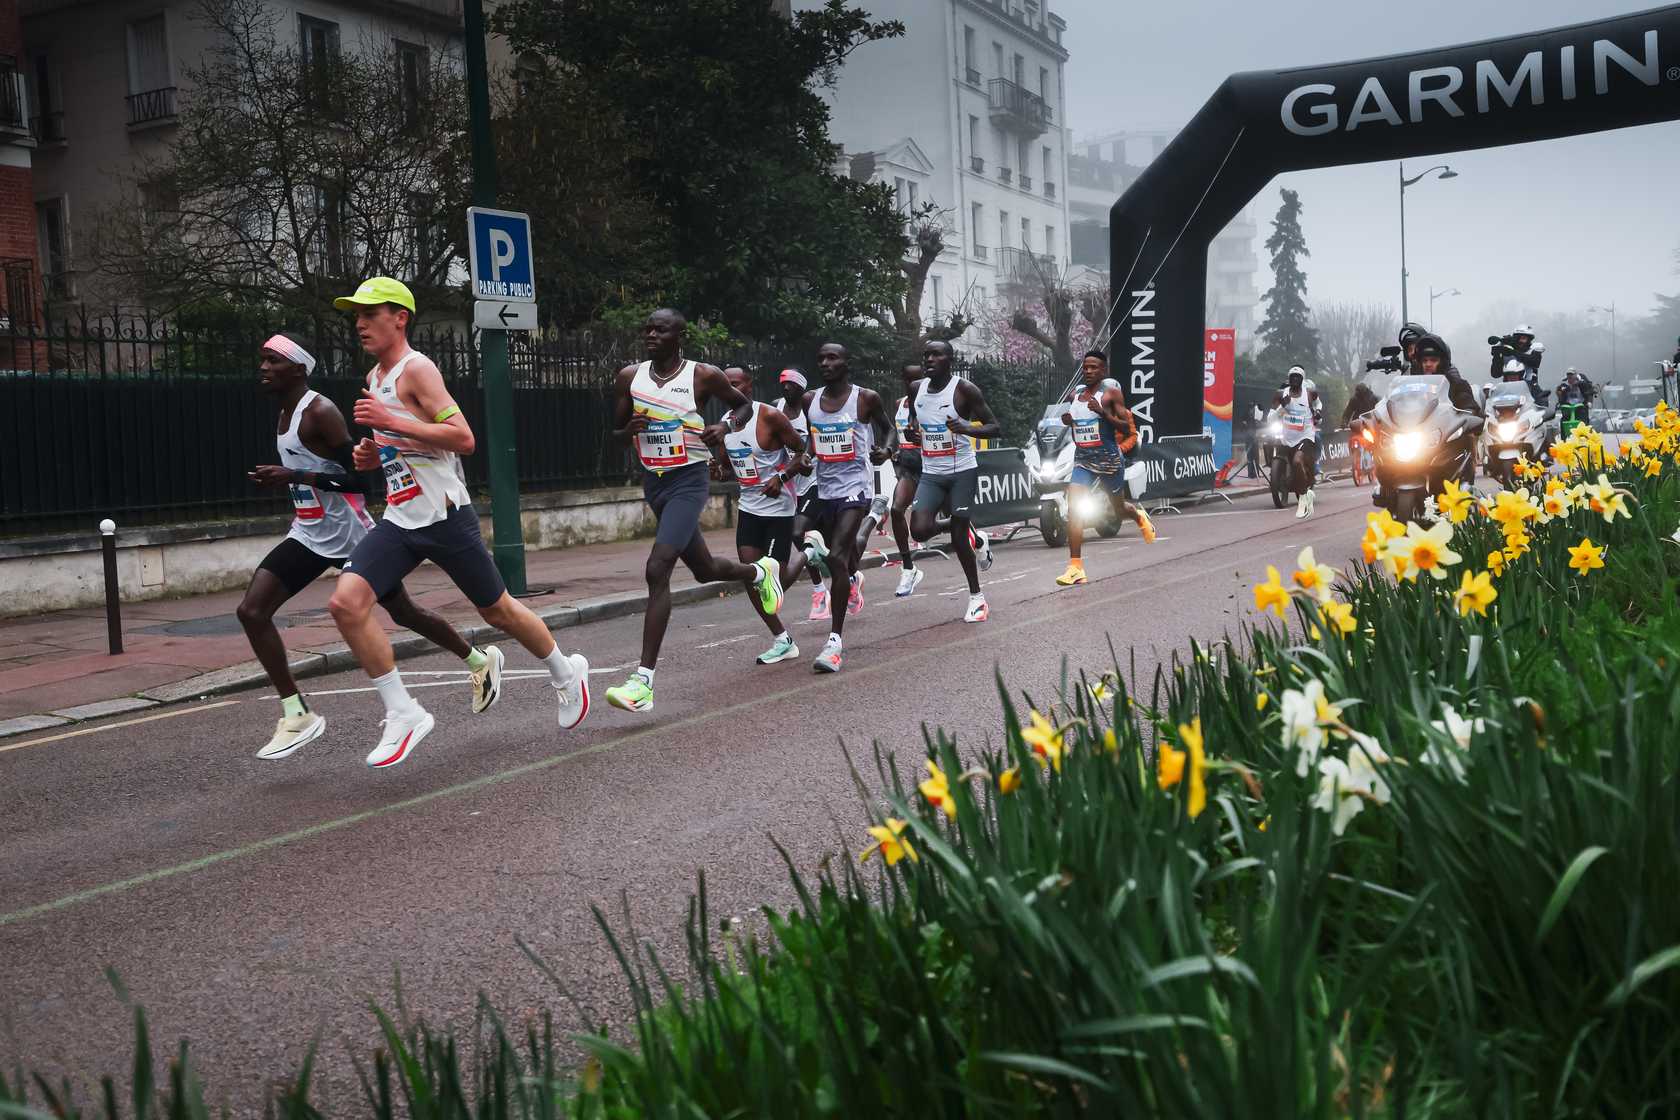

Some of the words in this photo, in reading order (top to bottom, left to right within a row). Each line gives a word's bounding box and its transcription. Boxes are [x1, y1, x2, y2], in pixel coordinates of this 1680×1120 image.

[1280, 29, 1660, 136] GARMIN
[488, 228, 515, 281] P
[479, 280, 508, 296] PARKING
[509, 282, 532, 297] PUBLIC
[646, 433, 672, 445] KIMELI
[818, 433, 846, 444] KIMUTAI
[657, 446, 663, 457] 2
[1173, 452, 1216, 480] GARMIN
[974, 470, 1032, 505] RMIN
